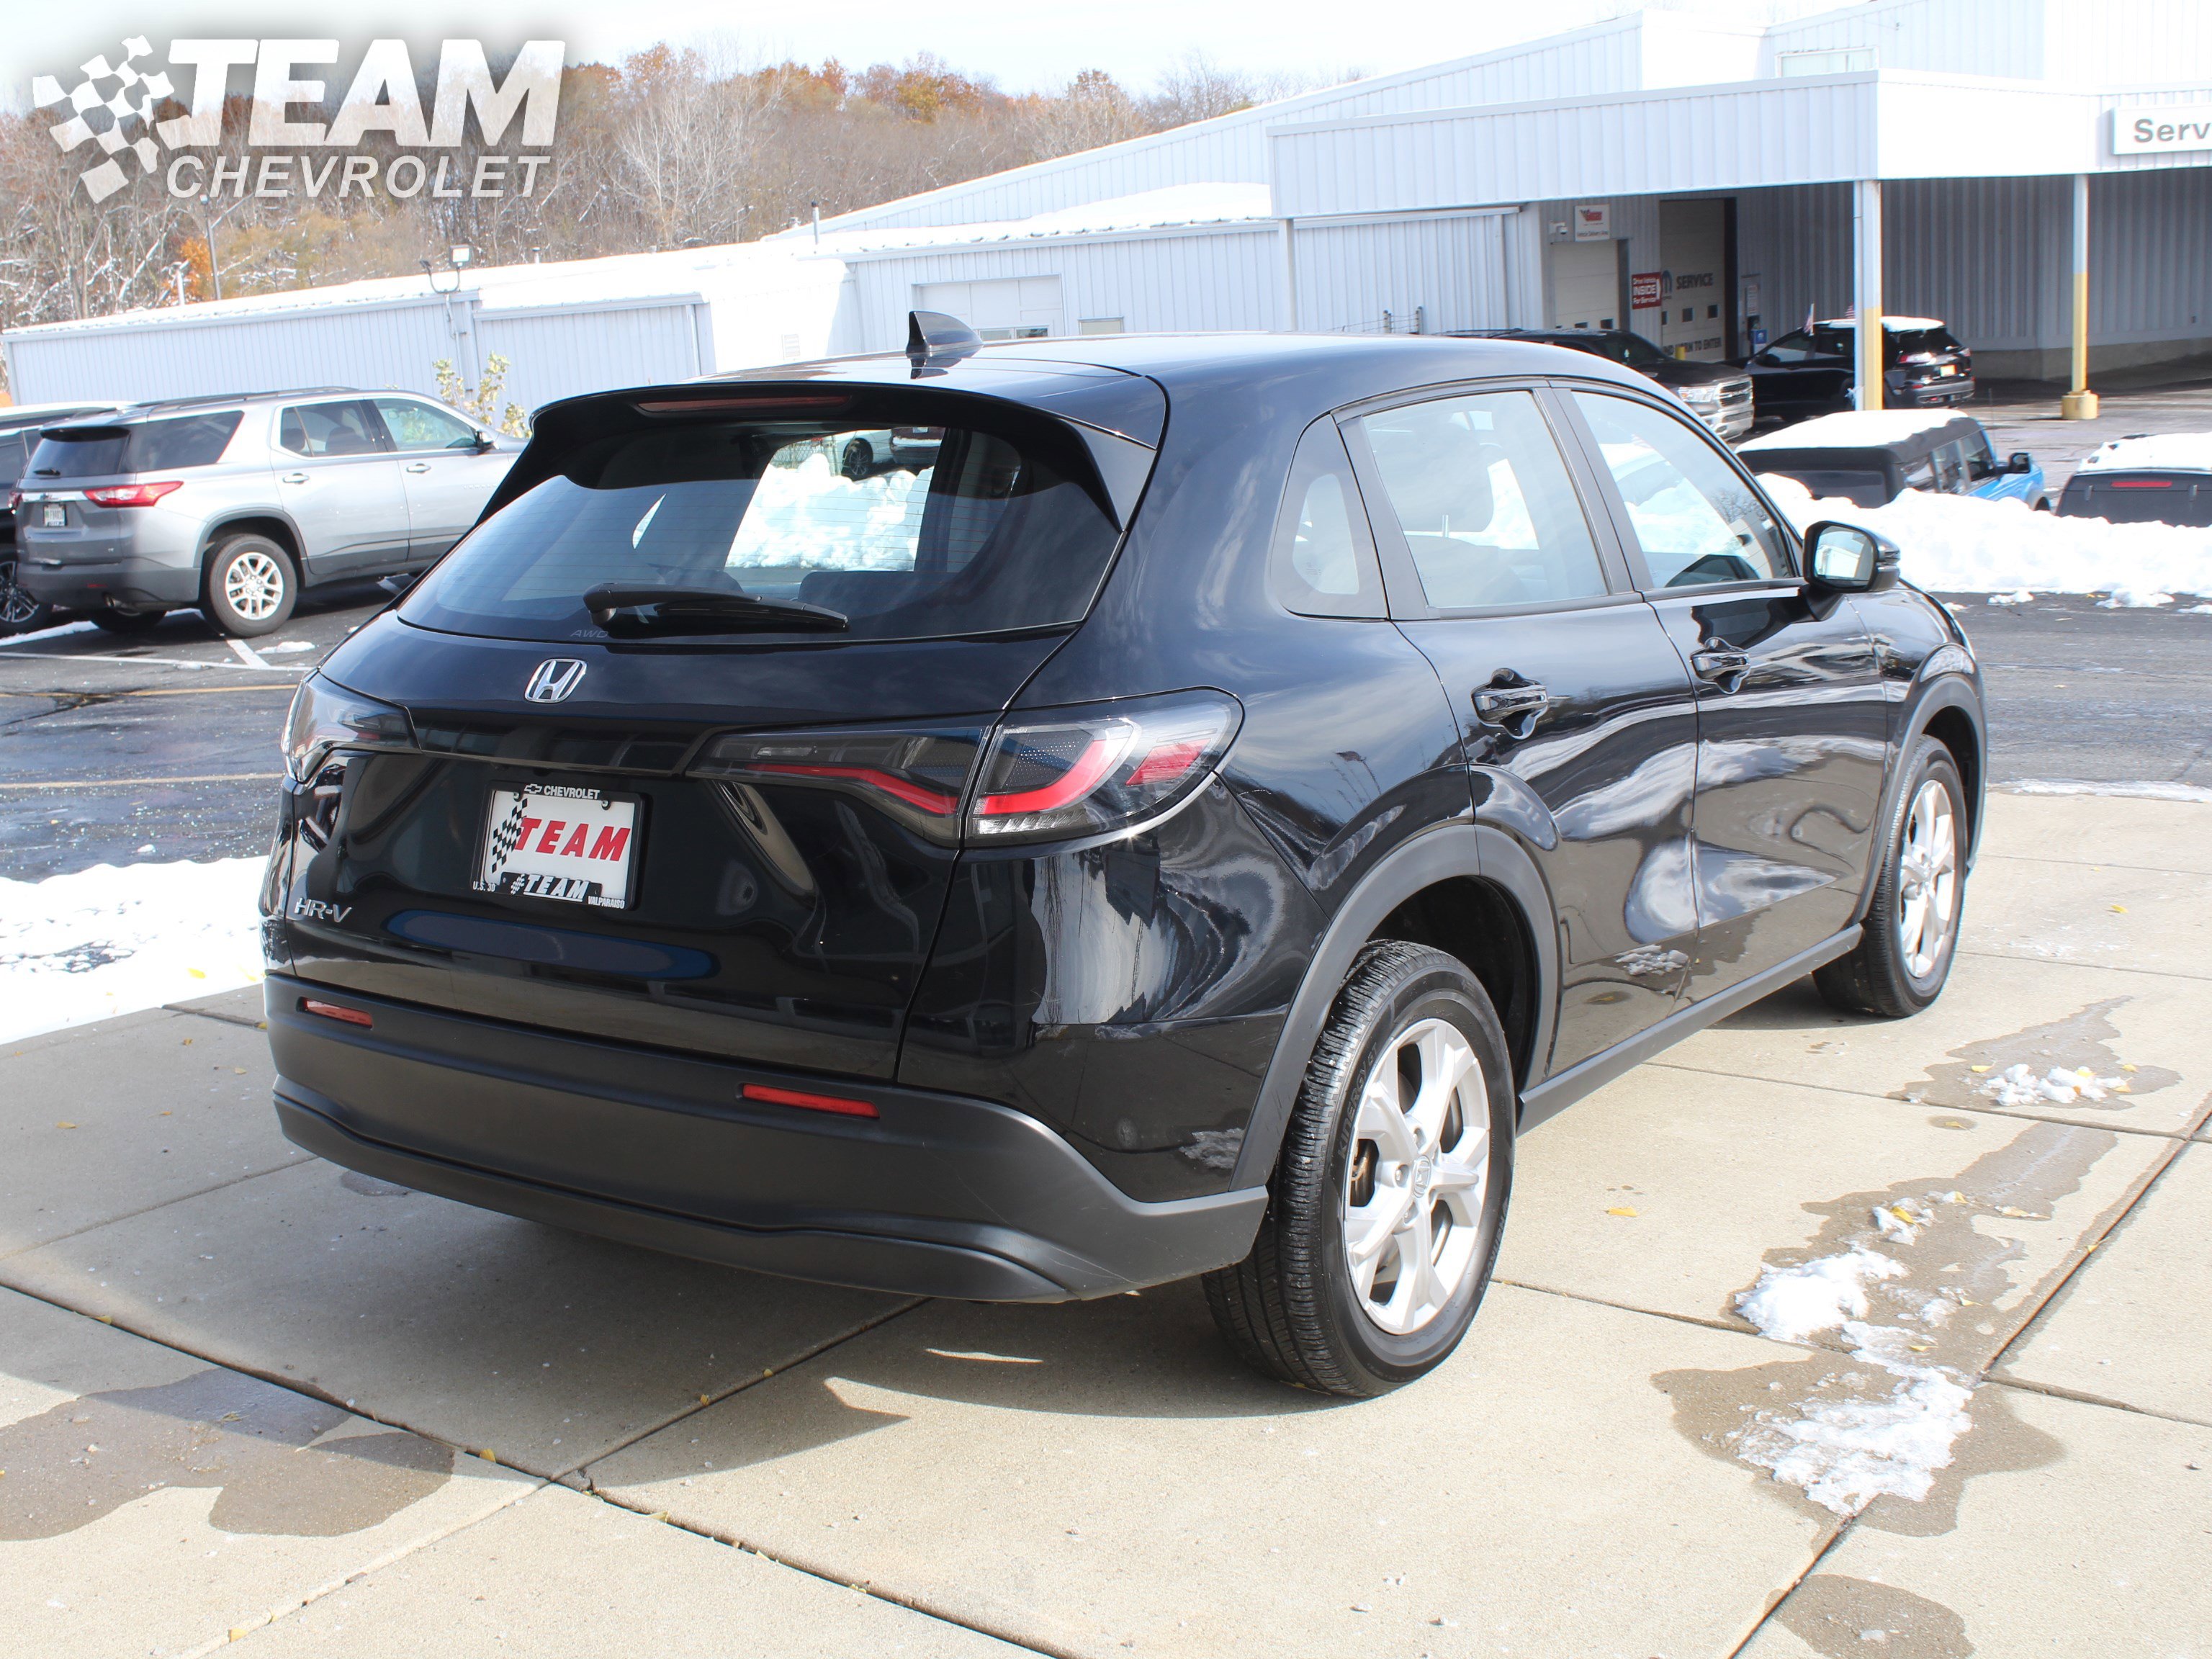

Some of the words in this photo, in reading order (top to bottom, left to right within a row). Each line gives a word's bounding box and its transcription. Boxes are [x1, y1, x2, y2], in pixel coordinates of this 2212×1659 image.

[2134, 118, 2211, 143] Serv
[1676, 274, 1713, 289] SERVICE
[1632, 284, 1657, 296] INSIDE
[570, 629, 608, 638] AWD
[544, 785, 601, 800] CHEVROLET
[514, 817, 631, 861] TEAM
[472, 881, 486, 891] U.S.
[487, 883, 496, 892] 30
[523, 874, 590, 900] TEAM
[588, 895, 625, 909] VALPARAISO
[294, 897, 353, 923] HR-V
